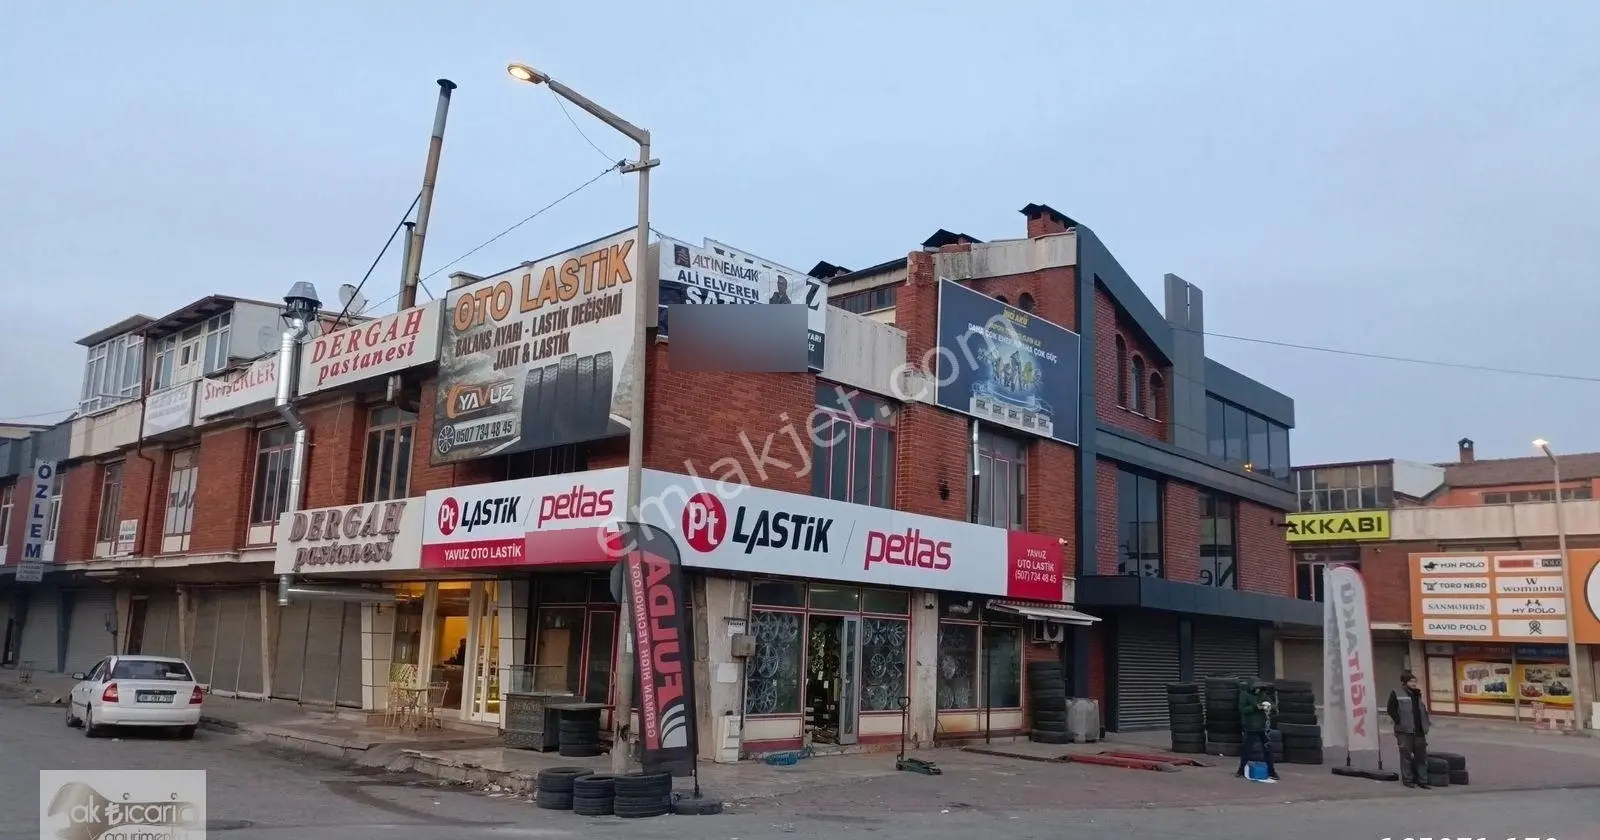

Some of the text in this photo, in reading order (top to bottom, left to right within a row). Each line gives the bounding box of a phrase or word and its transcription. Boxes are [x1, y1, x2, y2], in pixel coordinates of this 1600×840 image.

[453, 239, 635, 332] OTO LASTİK
[678, 269, 759, 301] ALİ ELVEREN
[311, 309, 424, 365] DERGAH
[455, 332, 491, 358] BALANS
[493, 322, 523, 347] AYARI
[532, 307, 569, 334] LASTİK
[571, 289, 623, 327] DEĞİŞİMİ
[317, 335, 415, 386] pastanesi
[493, 332, 570, 371] JANT & LASTİK
[459, 384, 513, 411] YAVUZ
[456, 421, 512, 443] 0507 734 48 45
[25, 460, 52, 558] ÖZLEM
[288, 501, 406, 543] DERGAH
[537, 484, 615, 529] petlas
[293, 534, 394, 571] pastanesi
[444, 542, 522, 561] YAVUZ OTO LASTİK
[863, 527, 952, 570] petlas
[1027, 549, 1047, 560] YAVUZ
[1032, 560, 1054, 572] LASTİK
[1015, 569, 1030, 582] (507)
[1030, 571, 1041, 581] 734
